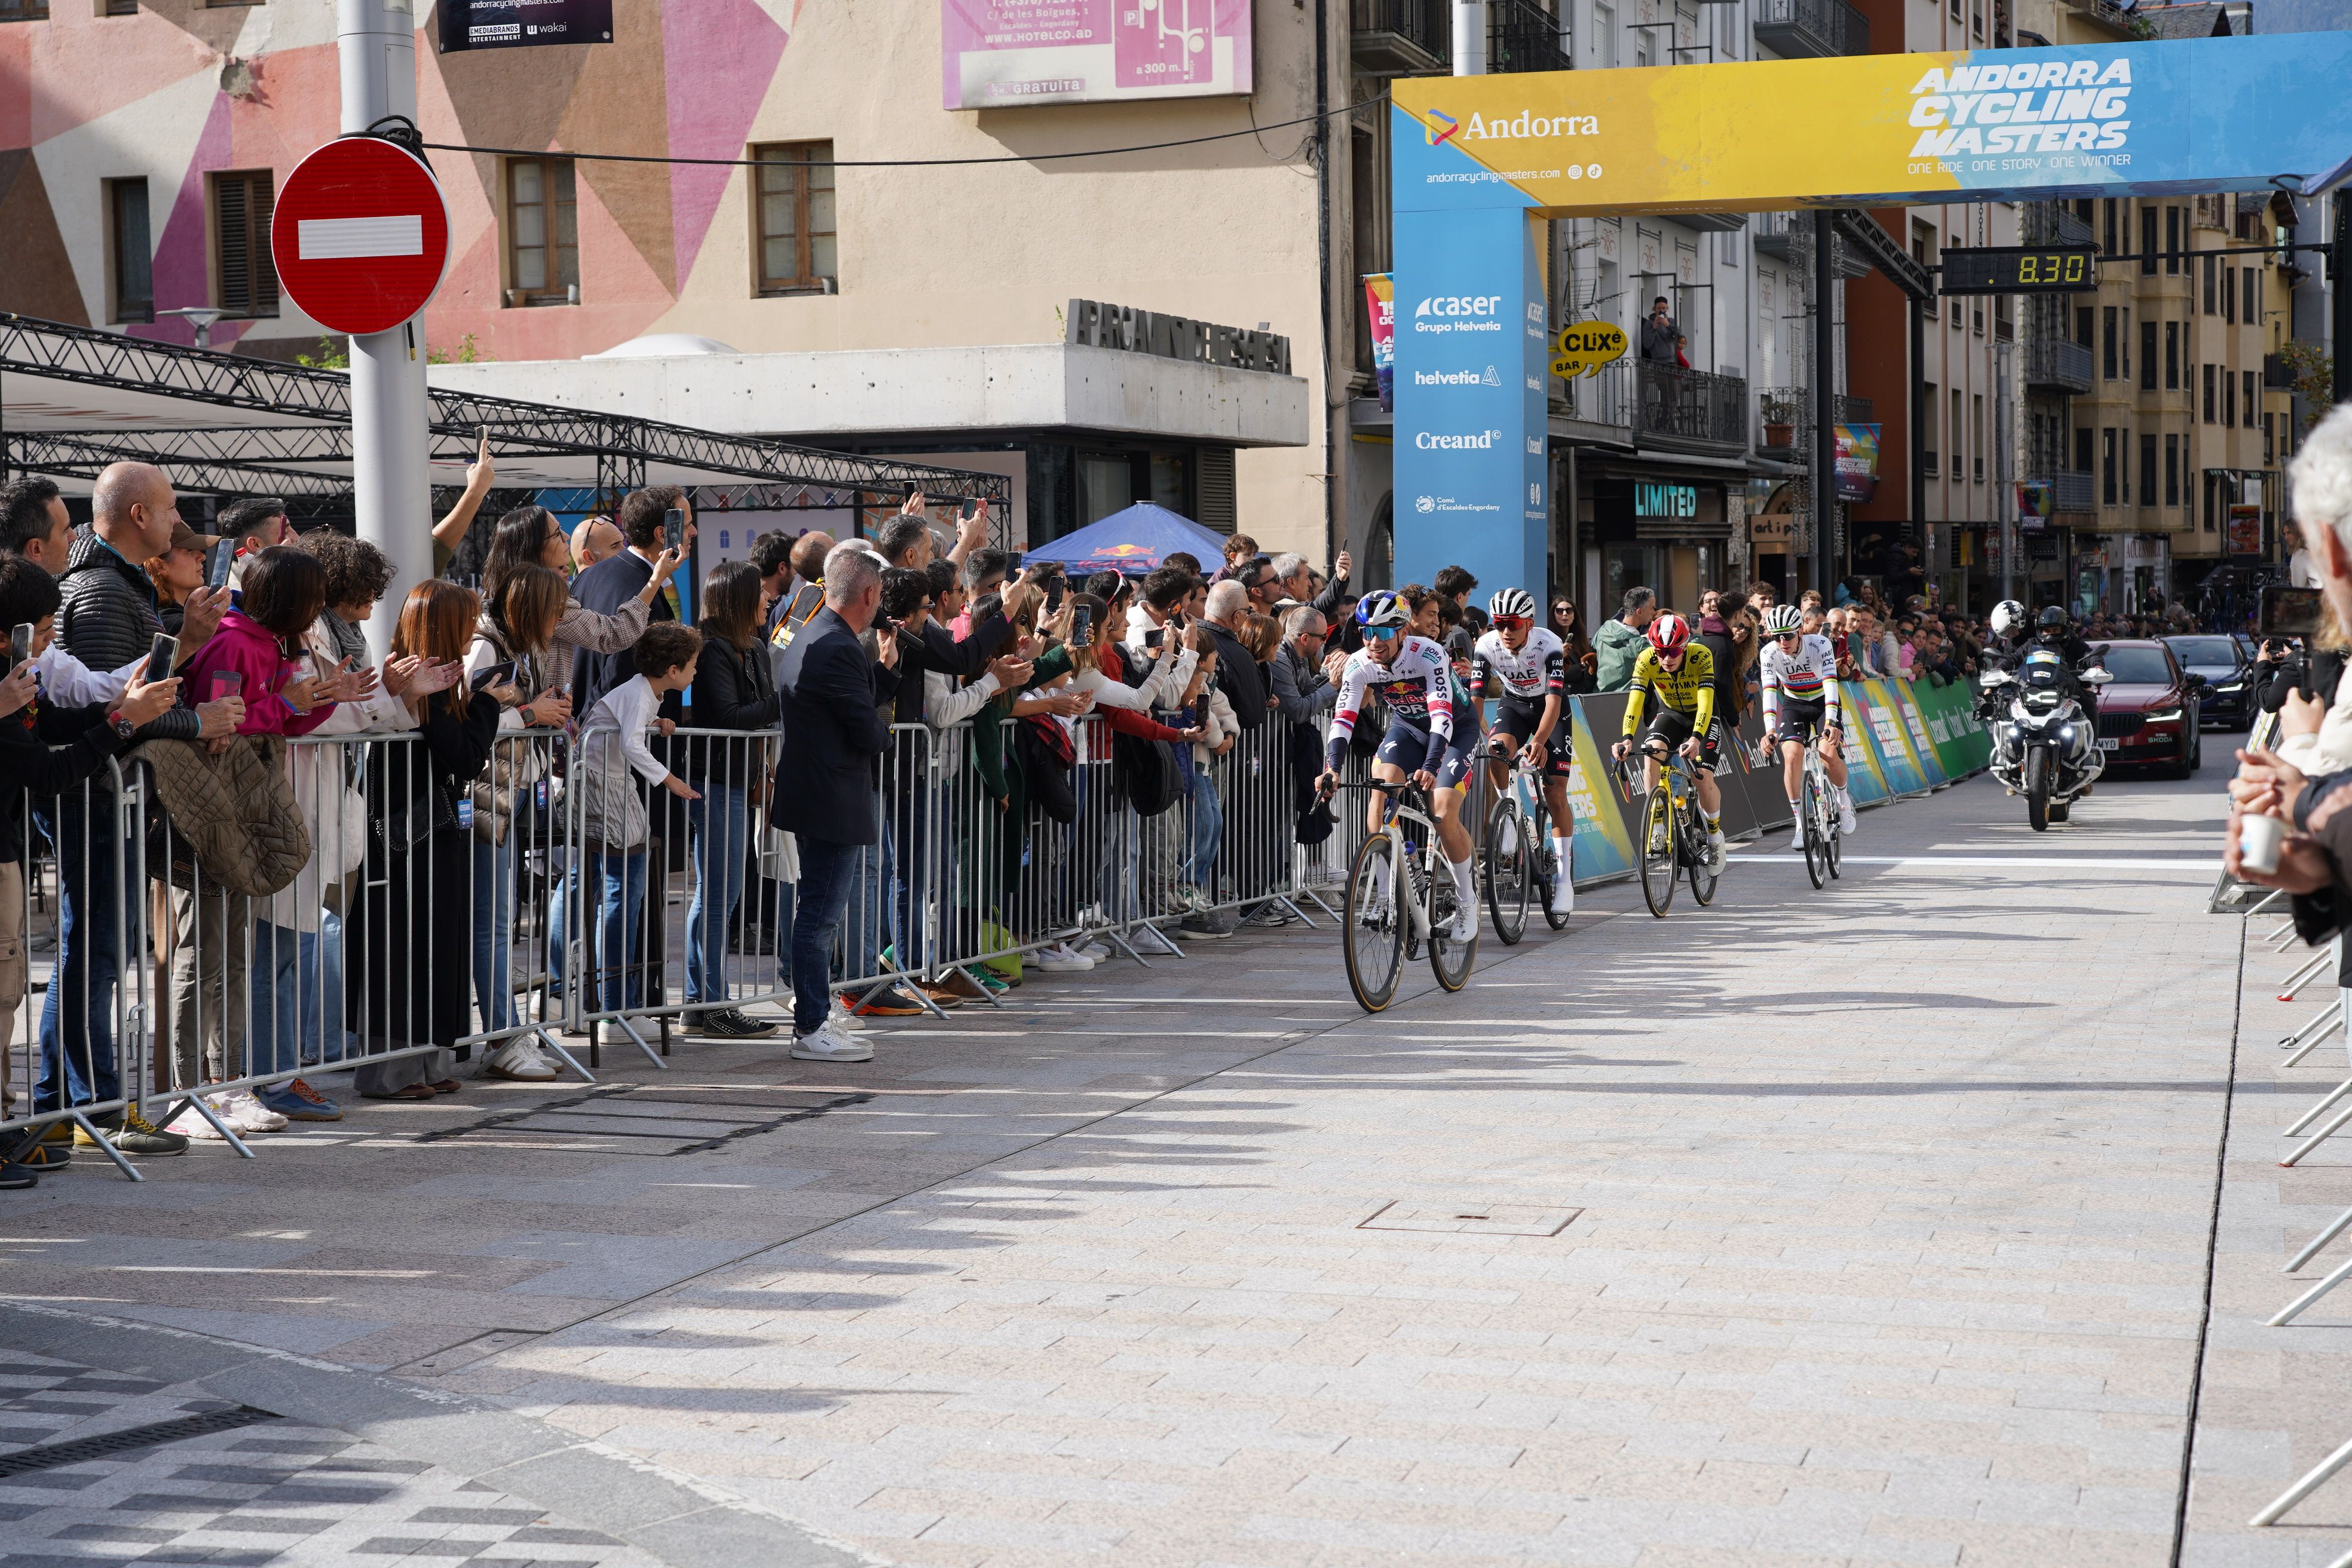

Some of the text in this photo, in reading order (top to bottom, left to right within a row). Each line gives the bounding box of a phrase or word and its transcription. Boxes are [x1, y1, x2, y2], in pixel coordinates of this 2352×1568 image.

[1002, 10, 1014, 19] de
[1018, 10, 1033, 18] les
[474, 25, 518, 34] MEDIABRANDS
[539, 22, 566, 33] wakai
[469, 34, 520, 42] ENTERTAINMENT
[1145, 63, 1166, 73] 300
[1910, 58, 2132, 94] ANDORRA
[1909, 87, 2132, 127] CYCLING
[1463, 109, 1599, 140] Andorra
[1909, 121, 2131, 158] MASTERS
[1908, 154, 2131, 174] ONE RIDE ONE STORY ONE WINNER
[1427, 168, 1560, 183] andorracyclingmasters.com
[1432, 296, 1501, 316] caser
[1415, 321, 1501, 334] Grupo Helvetia
[1556, 360, 1580, 372] BAR
[1415, 370, 1480, 385] helvetia
[1836, 437, 1852, 446] 19
[1635, 483, 1696, 517] LIMITED
[1754, 519, 1774, 534] art
[1777, 522, 1781, 533] i
[1078, 558, 1159, 568] Red Bull
[1520, 599, 1530, 611] MET
[1425, 647, 1442, 662] BORA
[1503, 669, 1538, 679] UAE
[1786, 664, 1812, 674] UAE
[1434, 667, 1447, 699] BOSS
[1668, 680, 1698, 690] VISMA
[1708, 723, 1719, 740] VISMA
